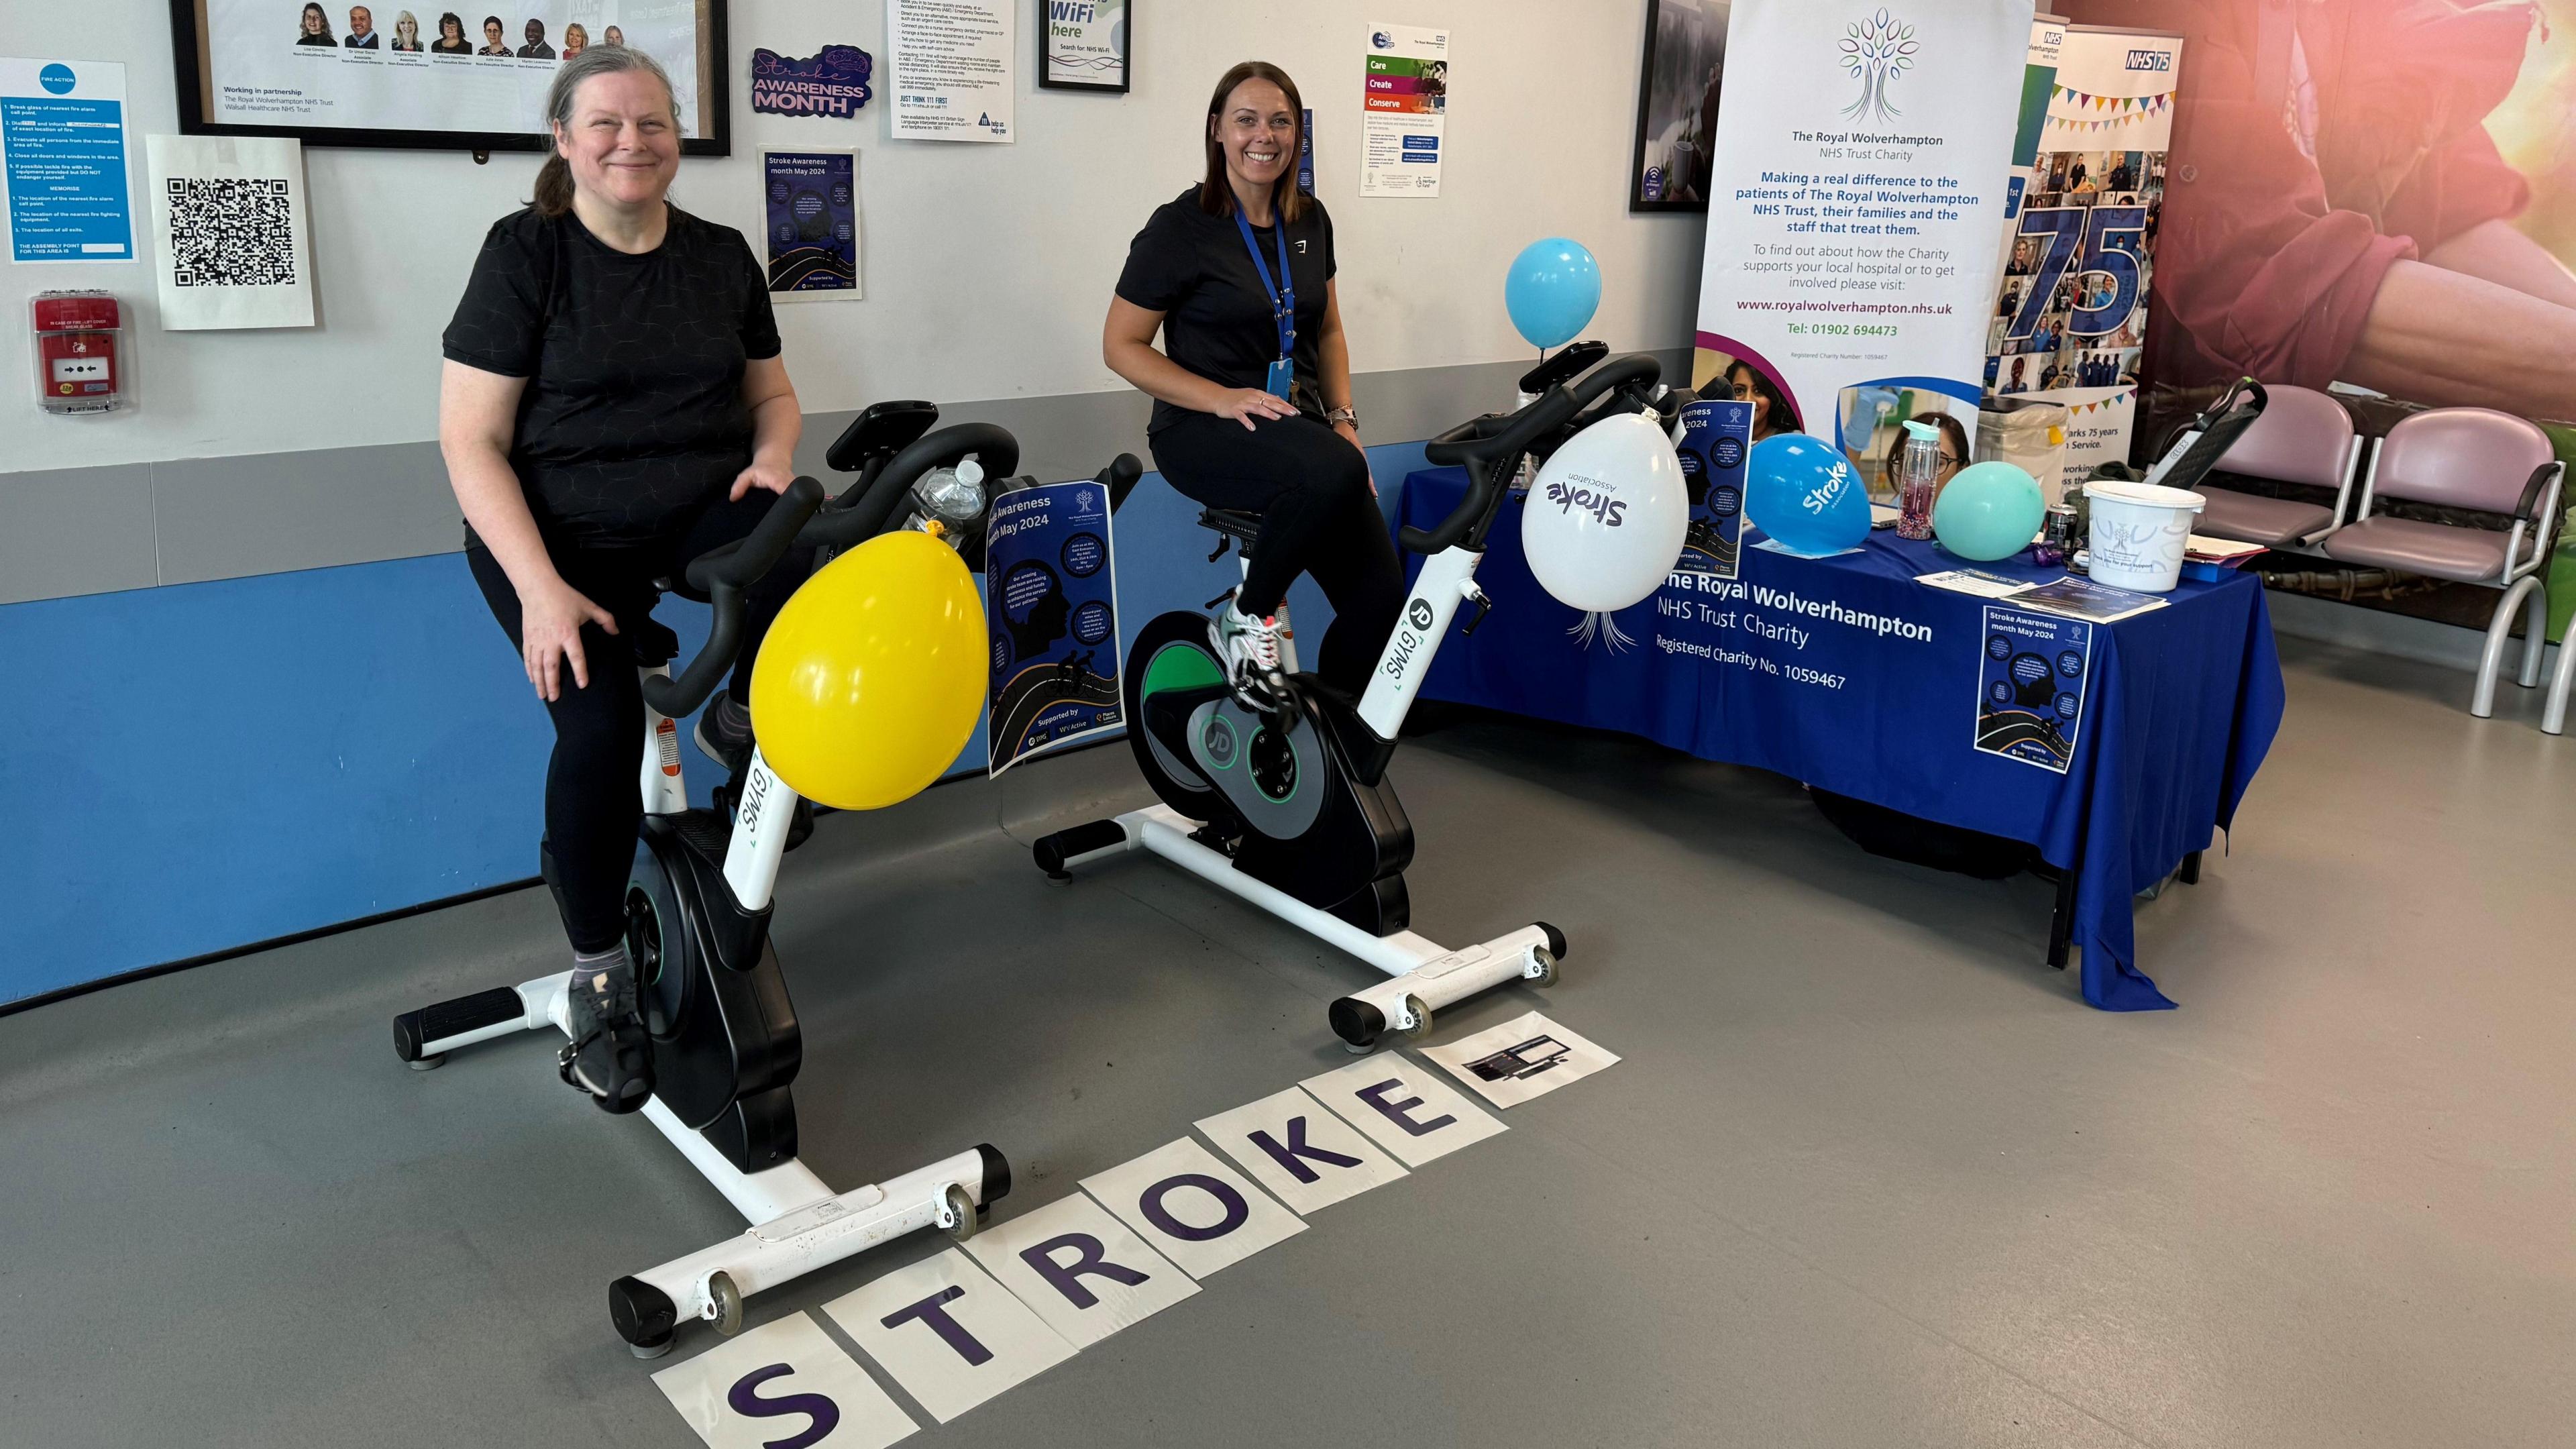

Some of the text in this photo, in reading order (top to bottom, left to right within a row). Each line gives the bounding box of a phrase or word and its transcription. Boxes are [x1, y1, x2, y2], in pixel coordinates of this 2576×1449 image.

[1051, 1, 1094, 23] WiFi
[1051, 22, 1081, 38] here
[2045, 32, 2061, 44] NHS
[755, 52, 850, 80] Stroke
[1371, 60, 1386, 69] Care
[2127, 52, 2169, 70] NHS 75
[754, 79, 864, 97] AWARENESS
[1370, 80, 1392, 89] Create
[256, 97, 303, 105] Wolverhampton
[755, 92, 847, 113] MONTH
[1368, 98, 1400, 107] Conserve
[1792, 131, 1943, 147] The Royal Wolverhampton
[1819, 148, 1913, 162] NHS Trust Charity
[1762, 172, 1808, 186] Making
[1824, 173, 1847, 184] real
[1852, 174, 1916, 186] difference
[1920, 177, 1932, 186] to
[1937, 176, 1957, 187] the
[1736, 188, 1978, 206] patients of The Royal Wolverhampton
[1754, 204, 1957, 219] NHS Trust, their families and the
[1787, 221, 1919, 235] staff that treat them.
[1754, 244, 1949, 262] To find out about how the Charity
[1743, 262, 1792, 273] supports
[1796, 264, 1822, 274] your
[1826, 261, 1853, 272] local
[1857, 262, 1901, 276] hospital
[1921, 265, 1931, 274] to
[1935, 266, 1954, 278] get
[2005, 205, 2147, 340] 75
[1789, 276, 1904, 291] involved please visit:
[1737, 300, 1952, 315] www.royalwolverhampton.nhs.uk
[1787, 323, 1897, 336] Tel: 01902 694473
[1686, 420, 1707, 429] 2024
[2069, 428, 2118, 438] arks 75 years
[2072, 440, 2101, 449] Service.
[2170, 439, 2189, 460] CLOX
[1568, 472, 1617, 492] Association
[1803, 461, 1847, 515] Stroke
[998, 498, 1051, 519] Awareness
[1546, 482, 1627, 527] Stroke
[1000, 515, 1049, 537] May 2024
[1660, 573, 1931, 642] he Royal Wolverhampton
[1410, 608, 1430, 627] JD
[1658, 596, 1809, 649] NHS Trust Charity
[1990, 612, 2057, 630] Stroke Awareness
[1991, 623, 2054, 640] month May 2024
[1386, 630, 1415, 680] GYMS
[1657, 634, 1845, 689] Registered Charity No. 1059467
[1038, 709, 1079, 727] Supported by
[1071, 720, 1087, 730] Active
[1209, 731, 1228, 753] JD
[743, 767, 766, 833] GYMS
[727, 1077, 1458, 1449] STROKE
